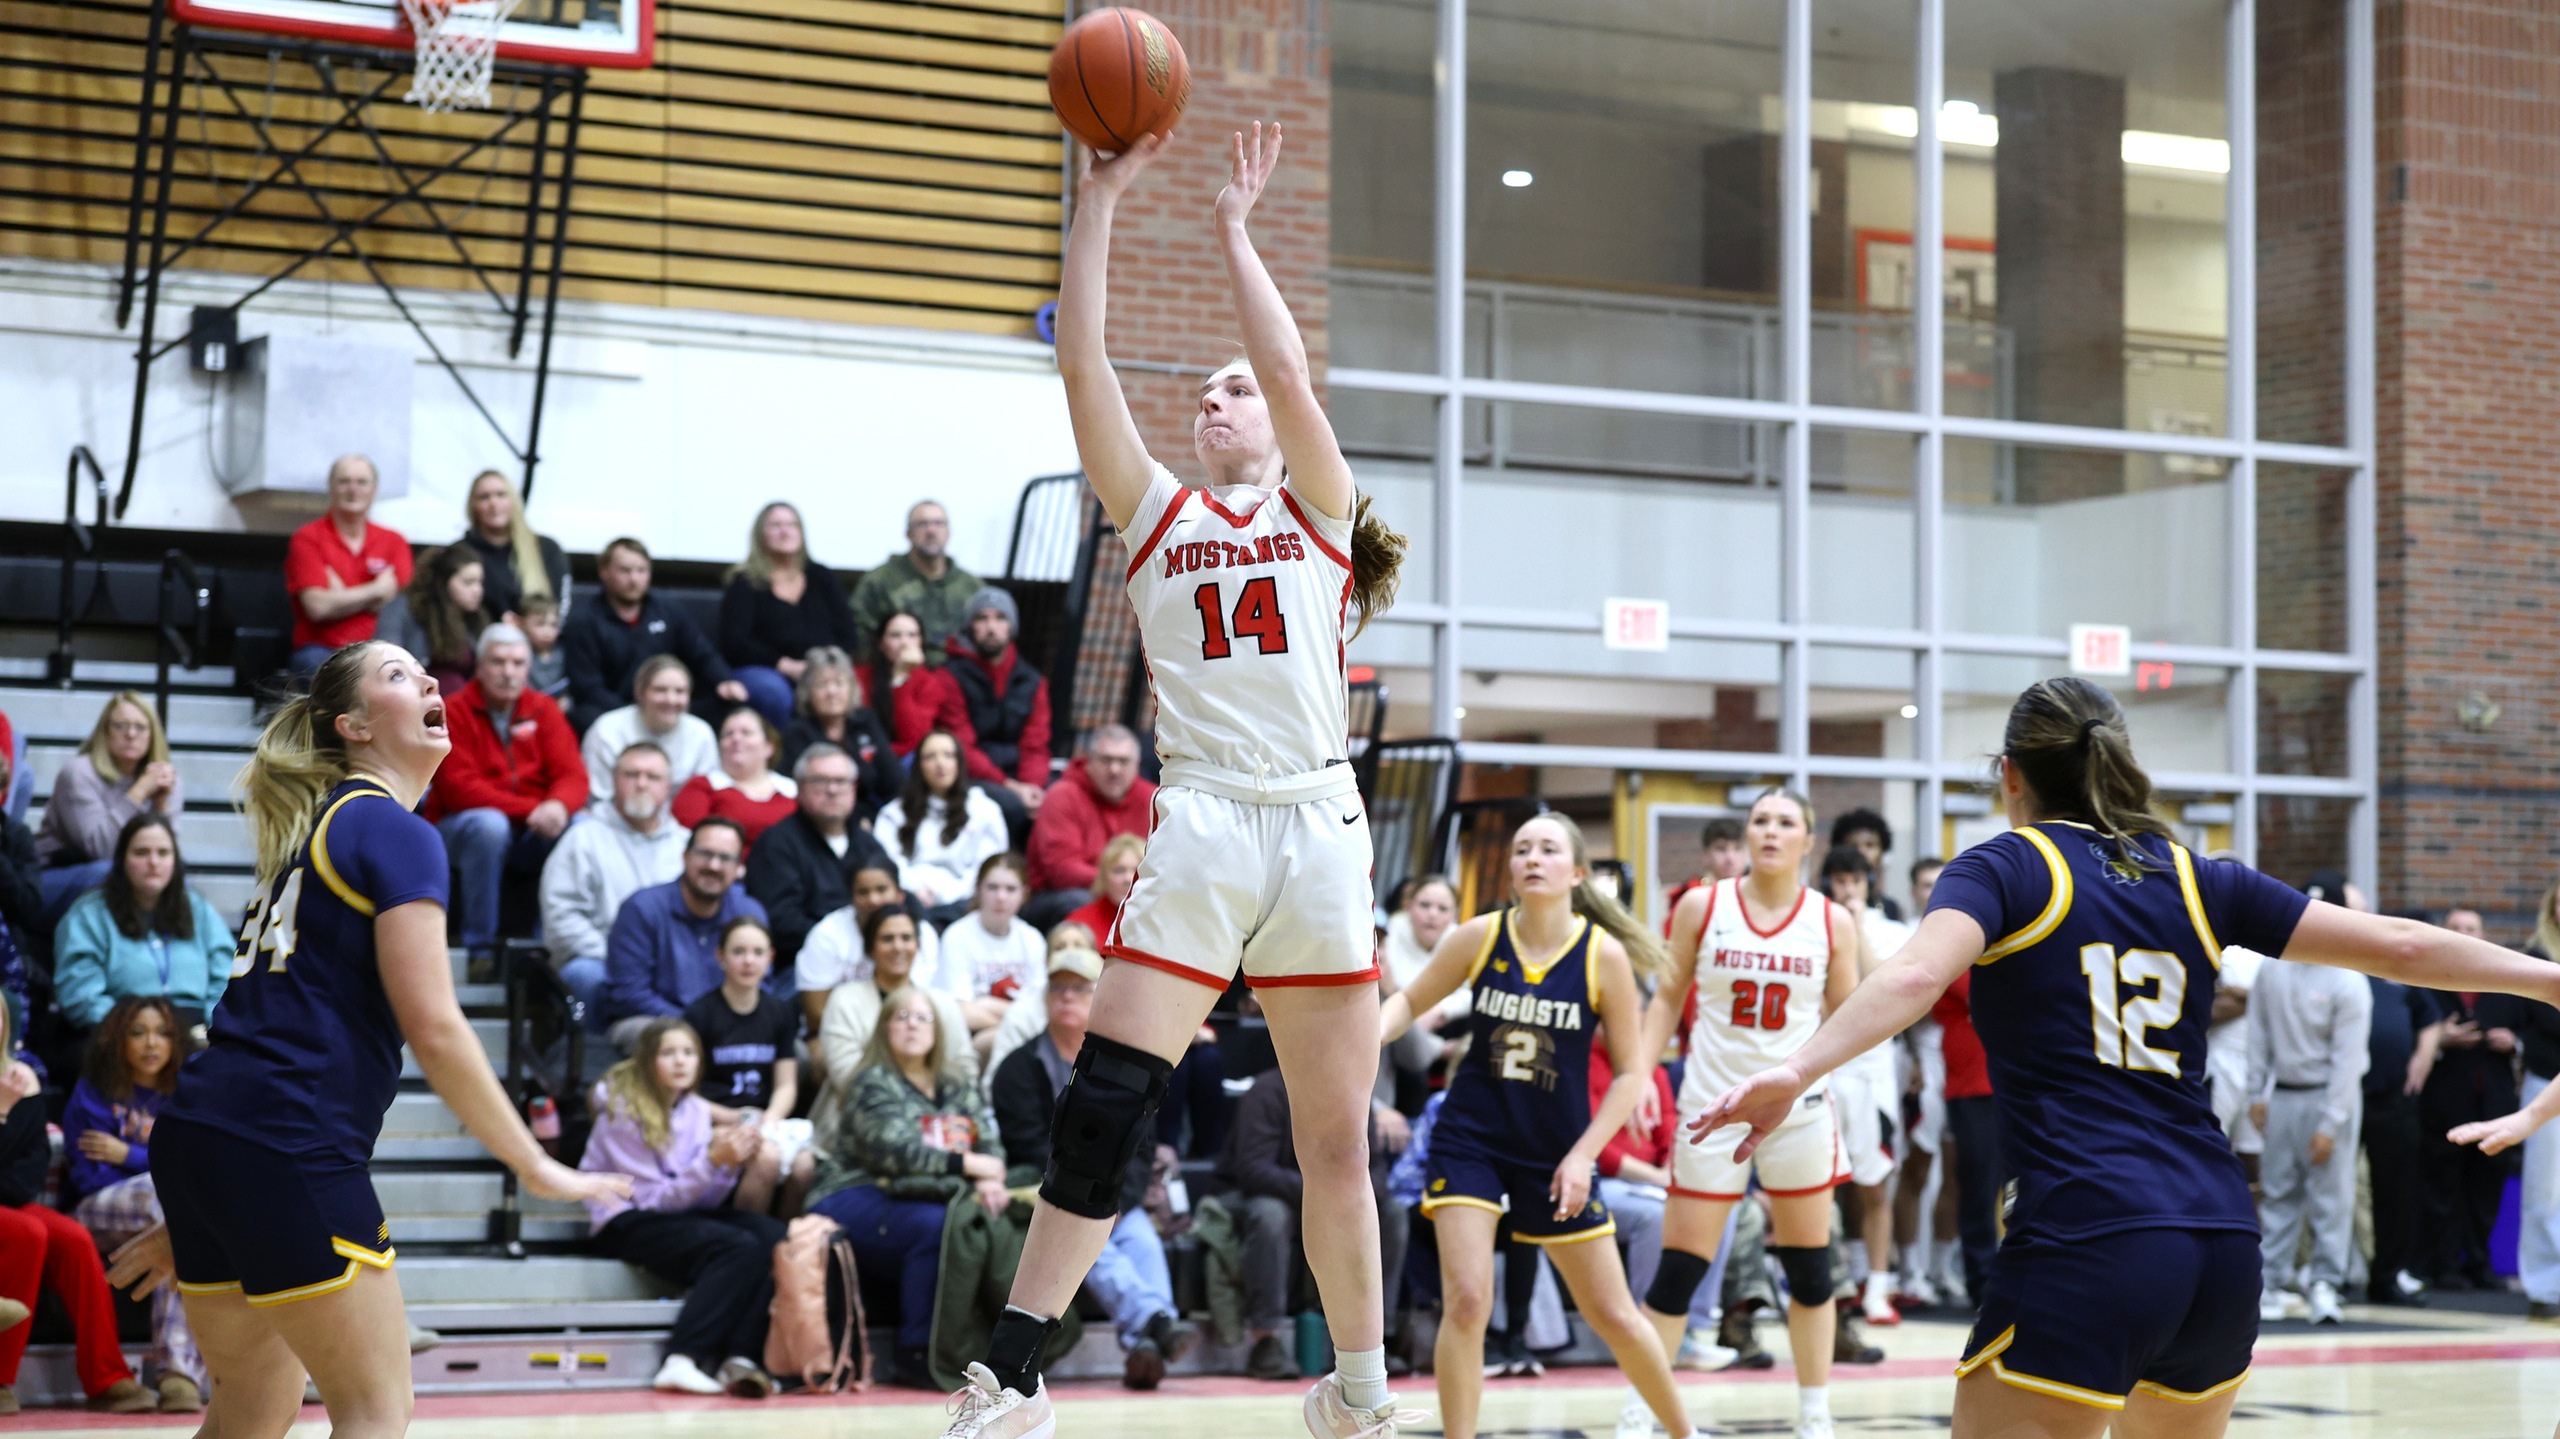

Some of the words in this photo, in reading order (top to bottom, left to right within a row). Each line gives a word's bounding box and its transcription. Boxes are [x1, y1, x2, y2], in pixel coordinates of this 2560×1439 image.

[1164, 531, 1306, 579] MUSTANGS
[1194, 576, 1289, 661] 14
[229, 866, 304, 978] 34
[1713, 948, 1813, 977] MUSTANGS
[1474, 985, 1582, 1031] AUGUSTA
[1730, 979, 1790, 1031] 20
[2079, 941, 2188, 1080] 12
[1502, 1029, 1538, 1080] 2
